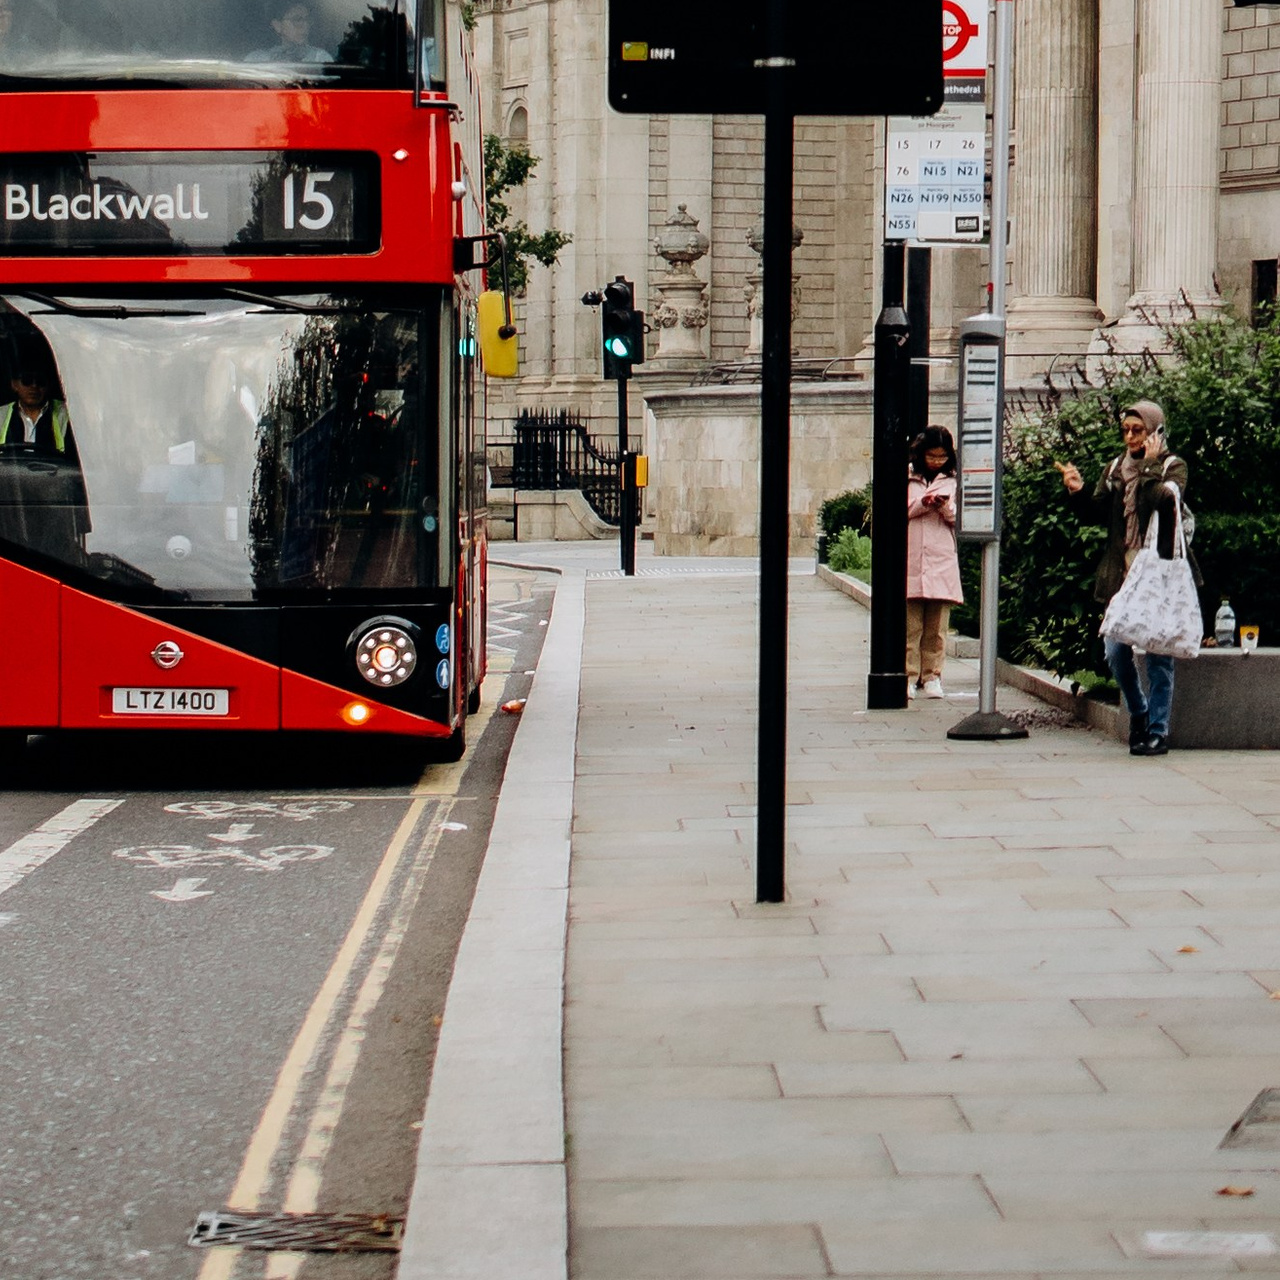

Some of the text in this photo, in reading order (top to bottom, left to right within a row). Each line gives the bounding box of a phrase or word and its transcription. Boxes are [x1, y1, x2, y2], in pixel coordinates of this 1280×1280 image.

[943, 26, 962, 35] TOP
[943, 85, 981, 95] athedral
[897, 140, 909, 150] 15
[929, 140, 941, 149] 17
[962, 140, 975, 149] 26
[897, 166, 909, 176] 76
[923, 166, 947, 176] N15
[957, 166, 979, 176] N21
[5, 183, 209, 220] Blackwall
[284, 171, 335, 230] 15
[890, 193, 914, 203] N26
[920, 193, 949, 203] N199
[953, 193, 981, 203] N550
[888, 220, 916, 229] N551
